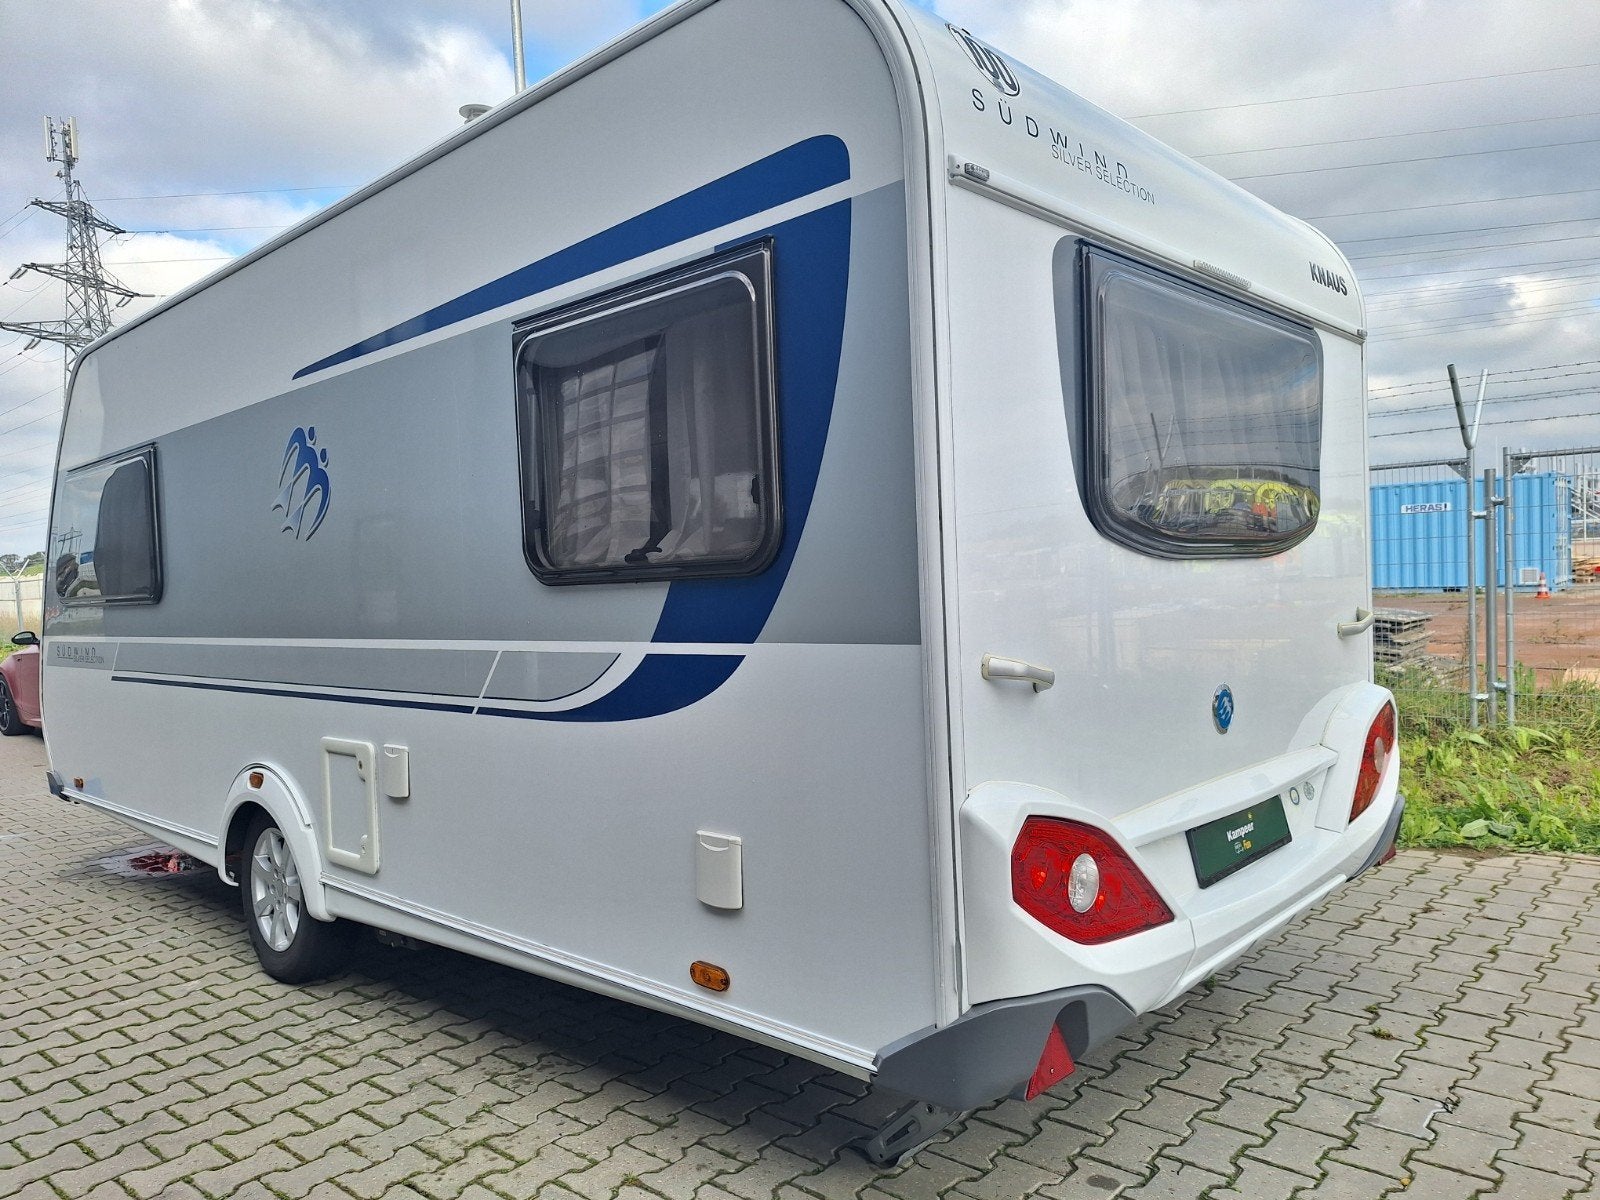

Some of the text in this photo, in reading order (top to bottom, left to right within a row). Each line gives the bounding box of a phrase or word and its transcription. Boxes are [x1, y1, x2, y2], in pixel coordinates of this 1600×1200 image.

[1051, 144, 1156, 205] SILVER SELECTION
[1308, 261, 1348, 296] KNAUS
[1226, 822, 1255, 842] Kampeer
